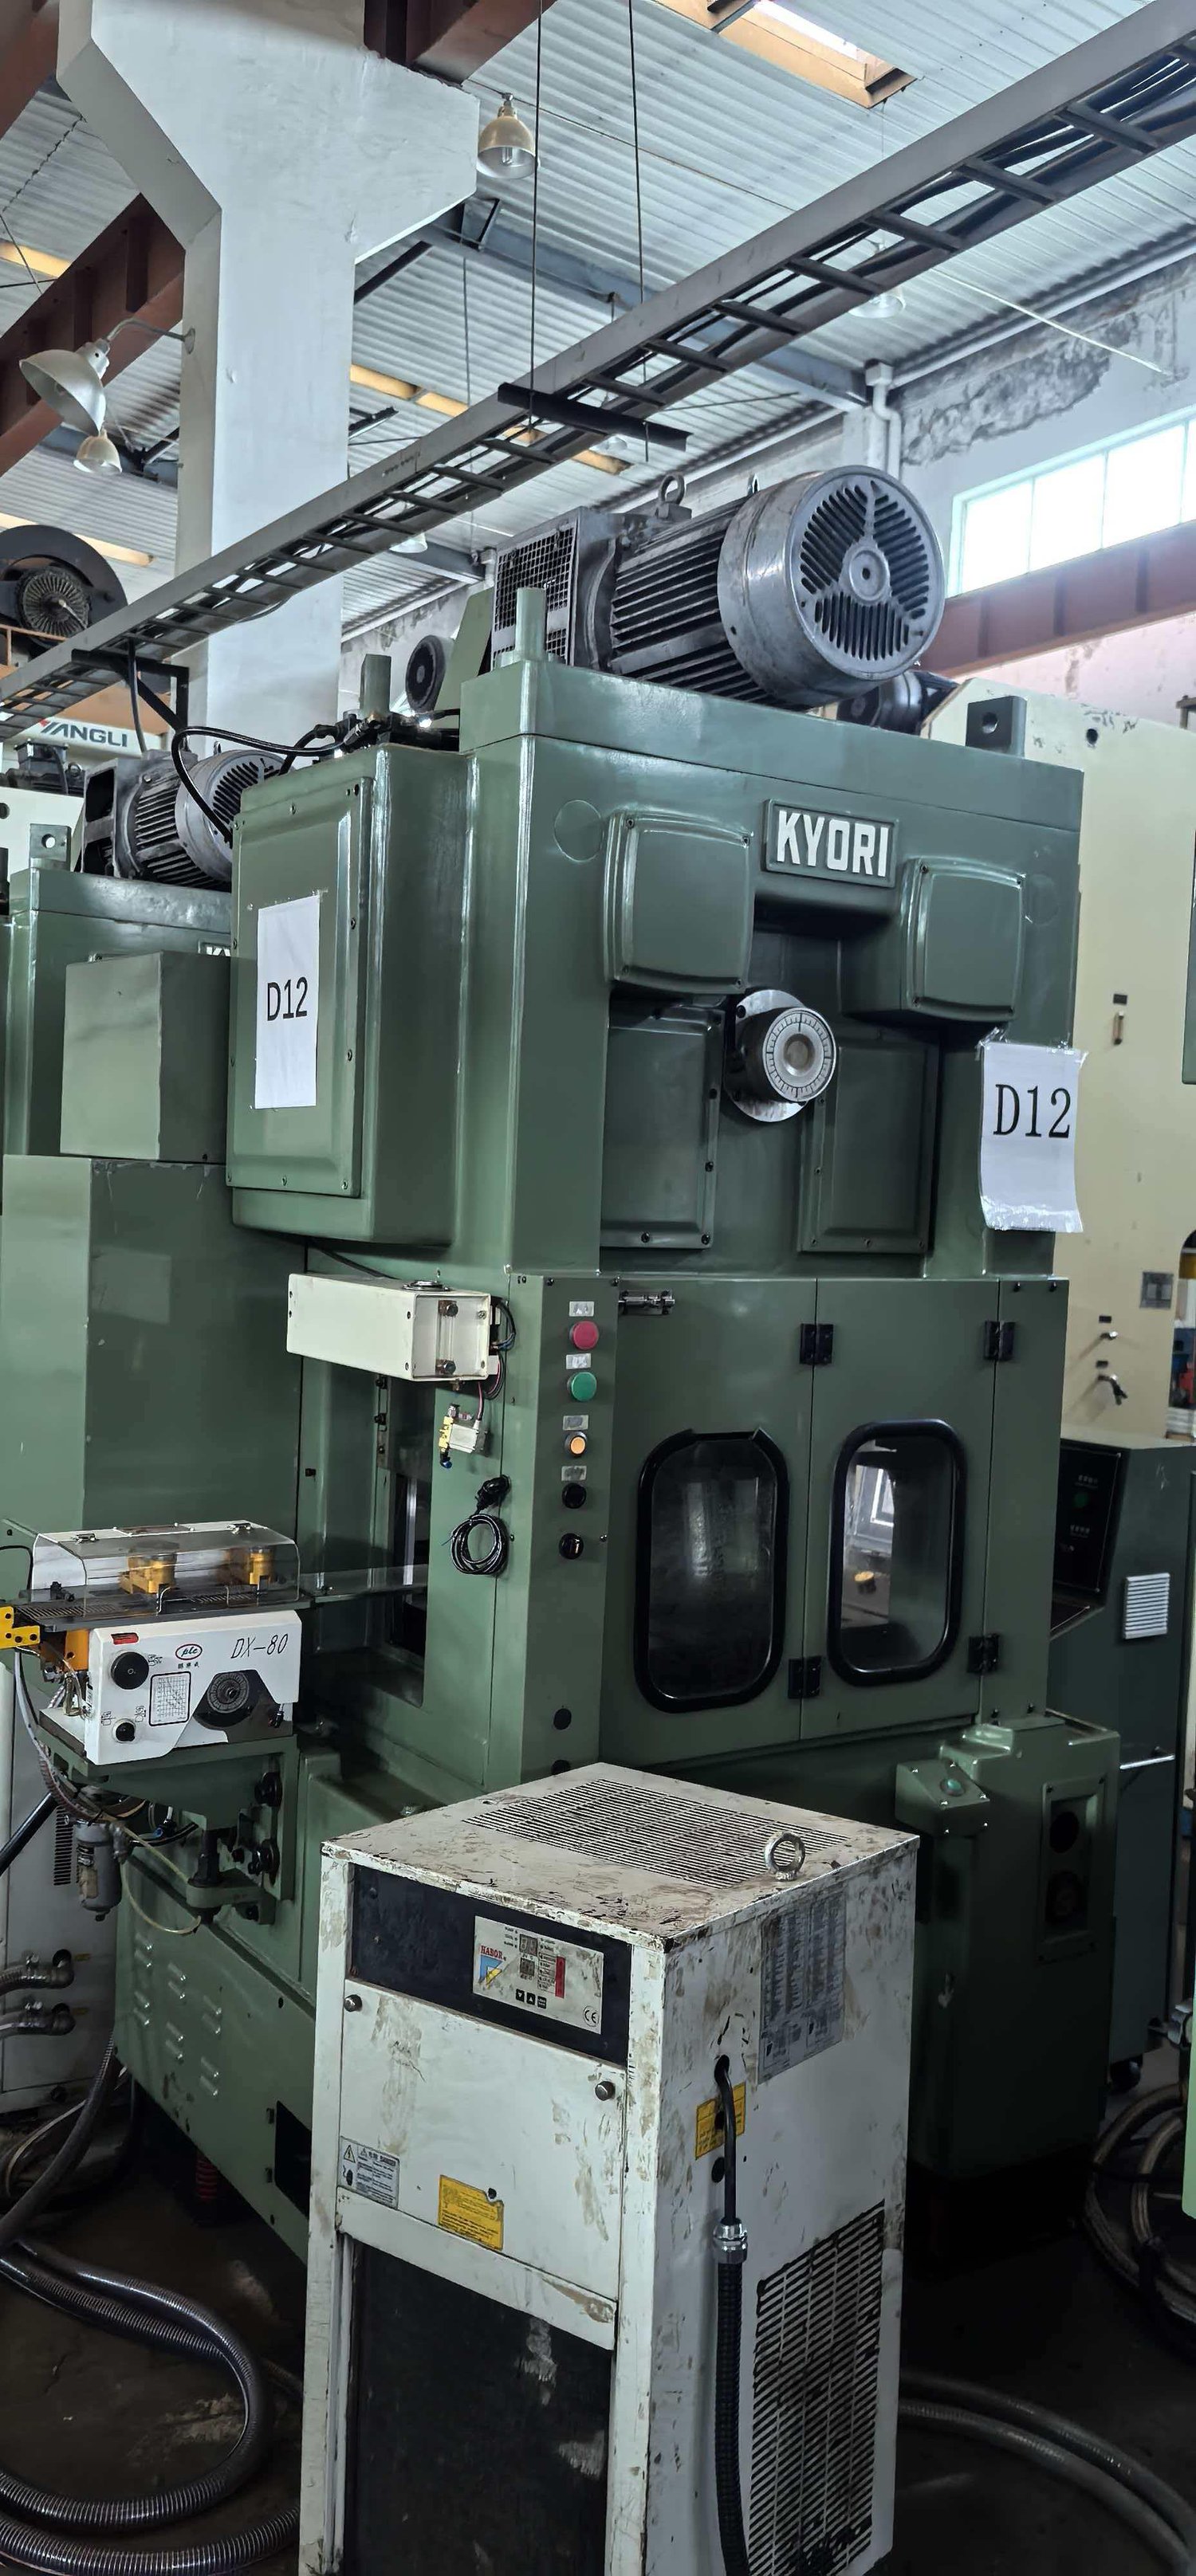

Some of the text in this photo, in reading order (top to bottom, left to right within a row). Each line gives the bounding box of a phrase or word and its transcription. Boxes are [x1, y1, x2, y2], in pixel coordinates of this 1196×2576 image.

[40, 719, 128, 748] YANGLI
[777, 810, 889, 878] KYORI
[267, 976, 308, 1021] D12
[993, 1084, 1072, 1139] D12
[230, 1633, 288, 1659] DX-80
[480, 1945, 503, 1960] HABOR
